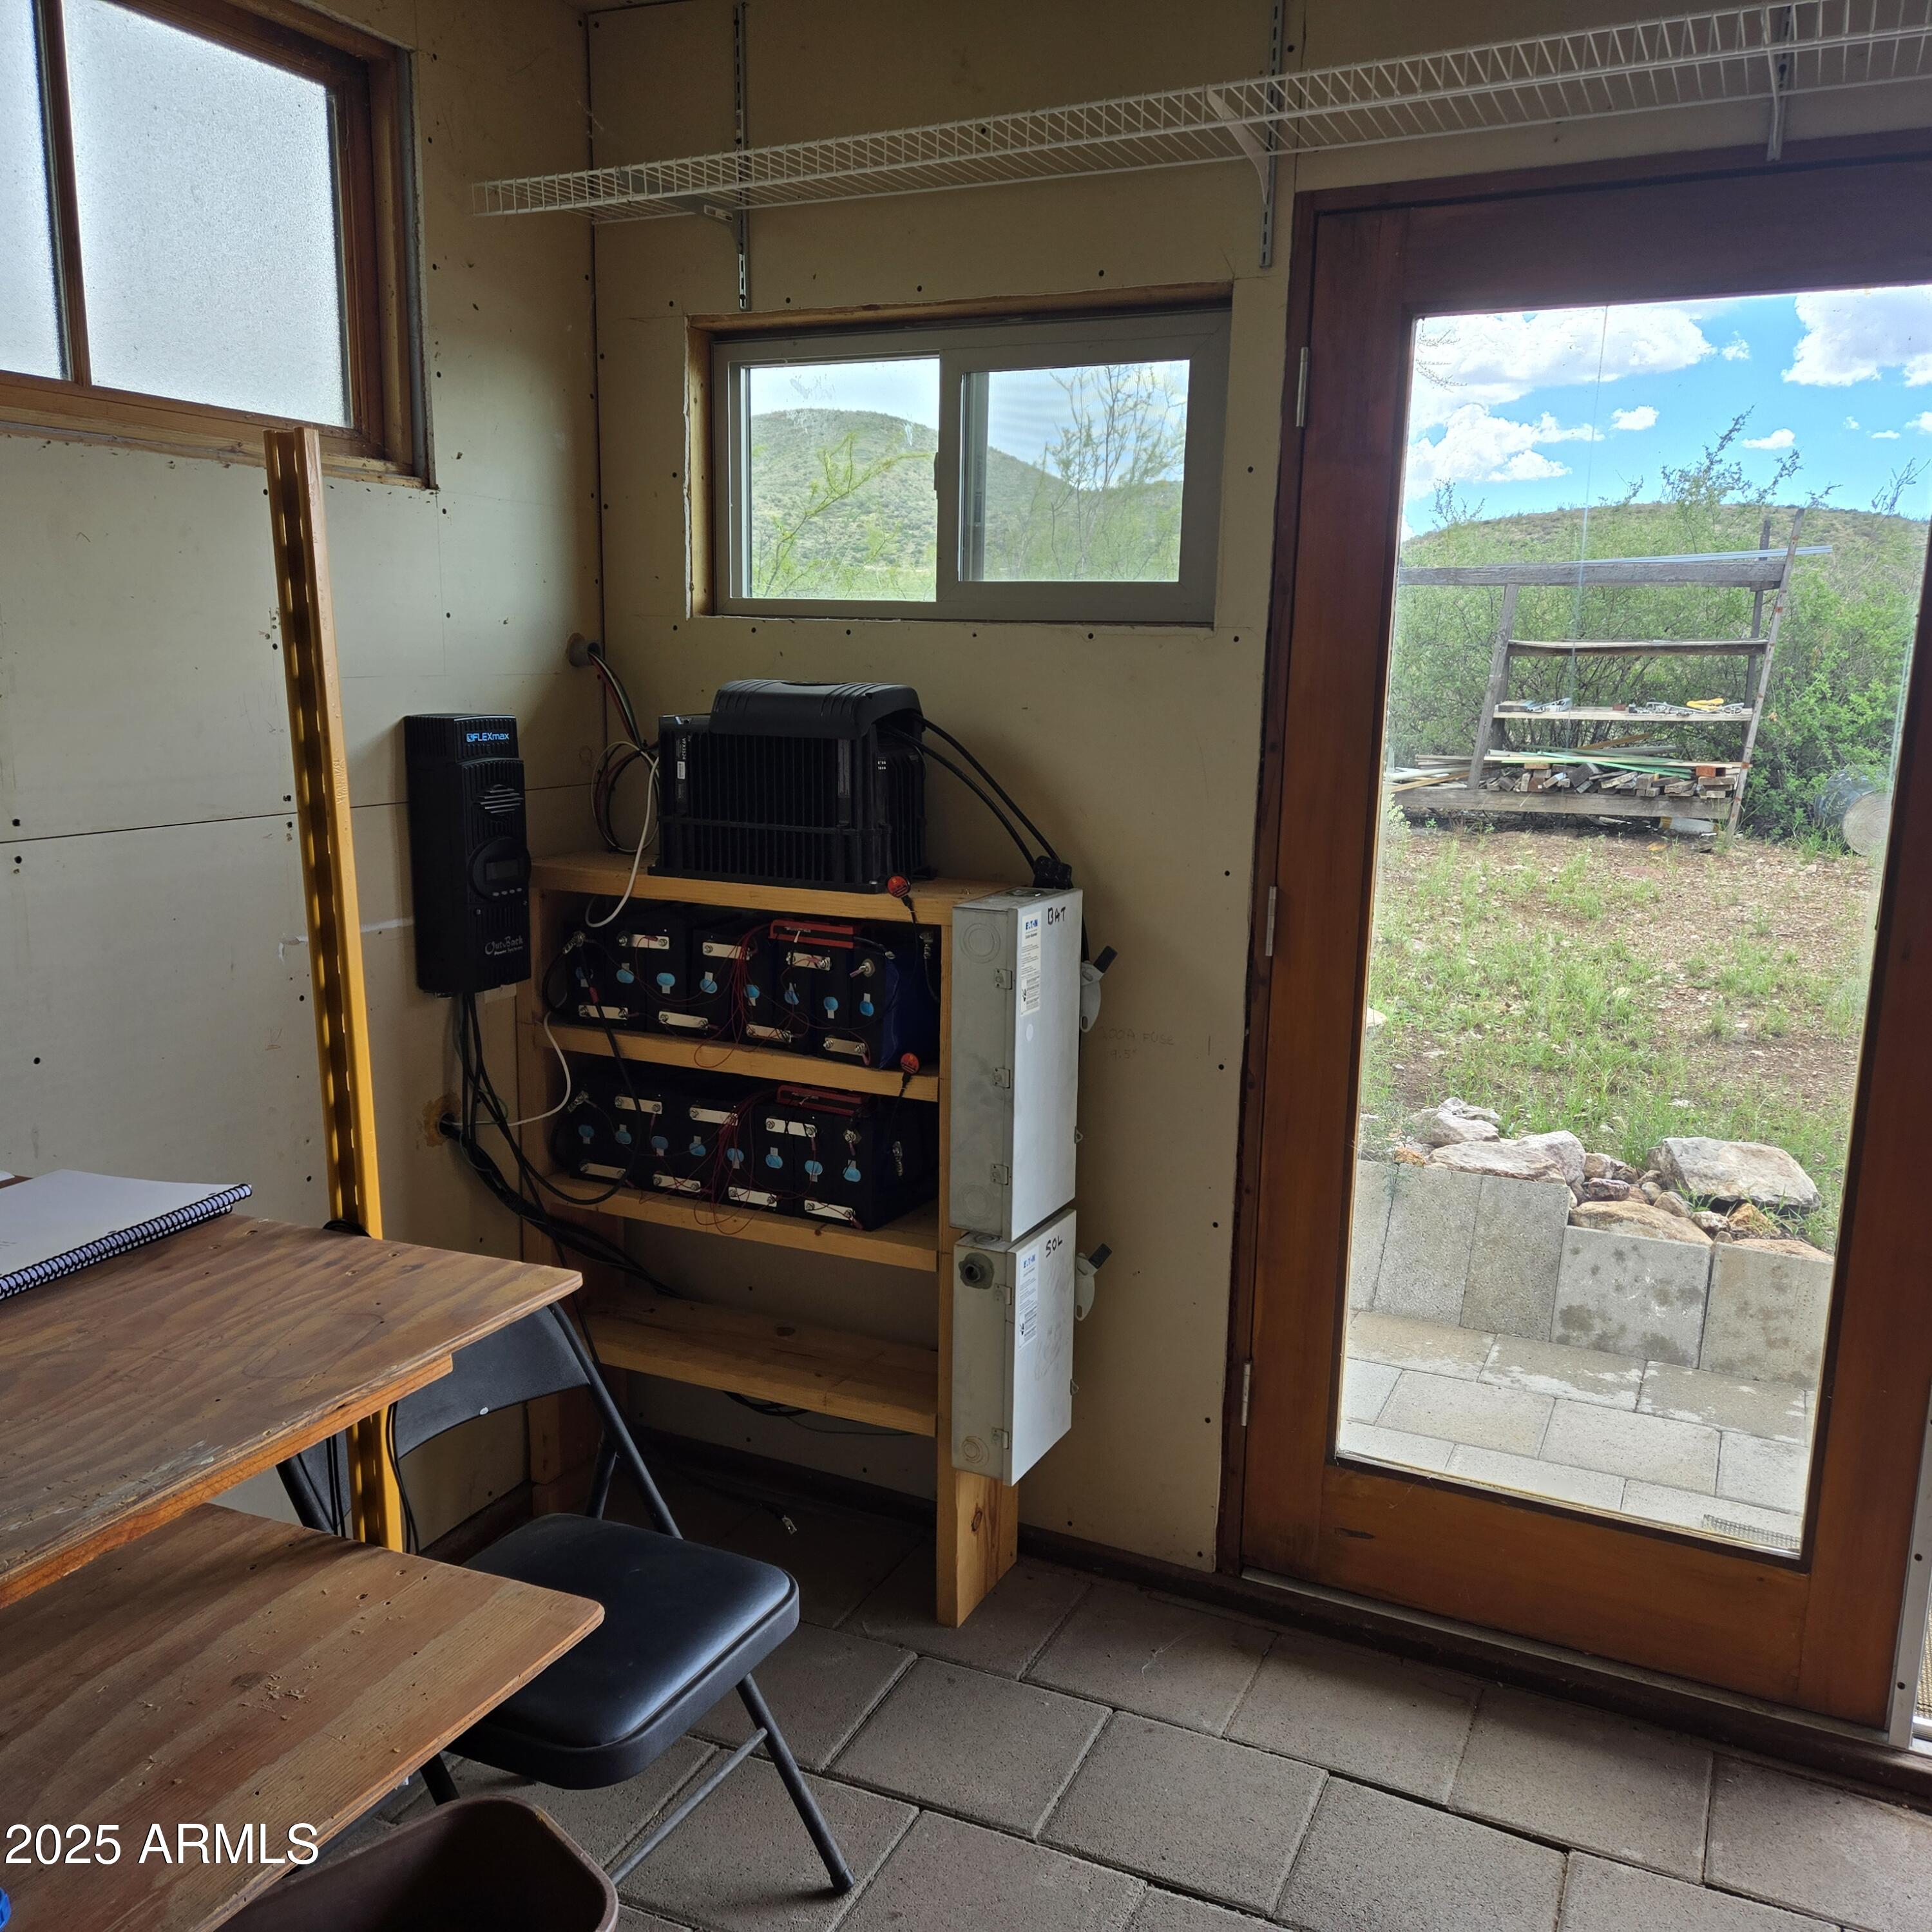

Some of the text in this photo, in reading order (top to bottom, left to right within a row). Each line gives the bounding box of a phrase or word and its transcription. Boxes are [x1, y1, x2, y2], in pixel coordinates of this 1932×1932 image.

[473, 732, 510, 741] FLEXmax
[1047, 906, 1066, 926] BAT
[1046, 1235, 1063, 1258] SOL
